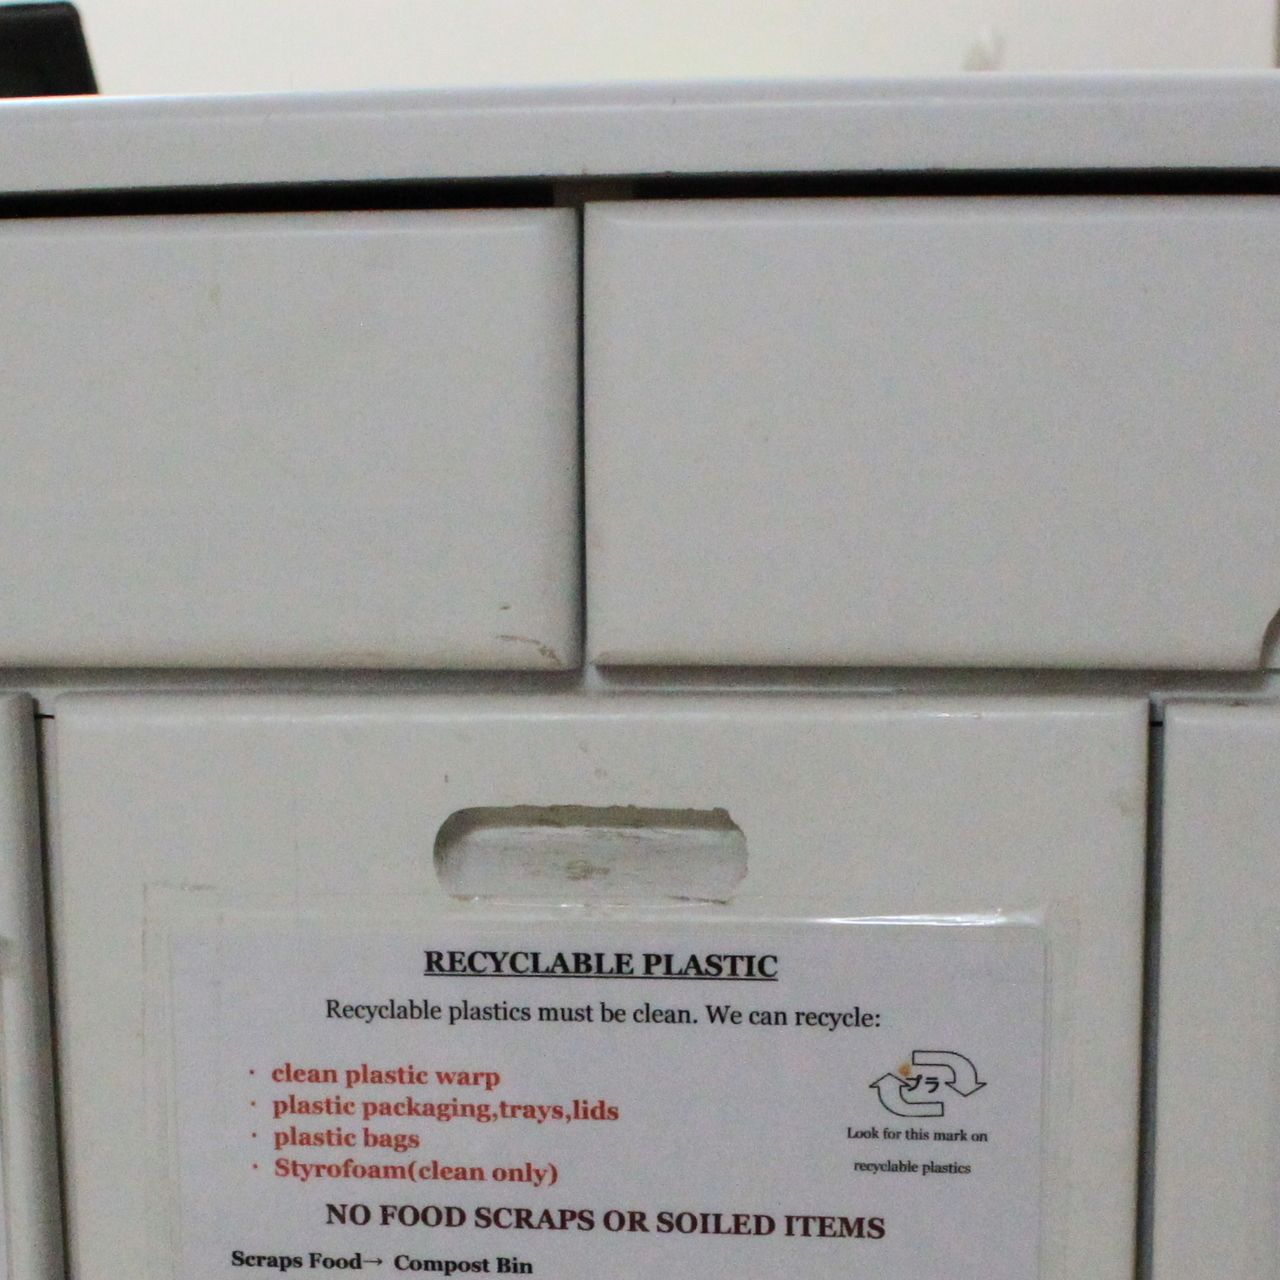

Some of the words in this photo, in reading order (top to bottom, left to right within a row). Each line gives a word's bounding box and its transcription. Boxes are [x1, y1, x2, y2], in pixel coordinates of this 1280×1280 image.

[423, 949, 635, 975] RECYCLABLE
[642, 952, 779, 978] PLASTIC
[325, 998, 443, 1025] Recyclable
[448, 998, 533, 1026] plastics
[537, 1004, 594, 1024] must
[599, 1000, 627, 1024] be
[631, 1001, 699, 1025] clean.
[704, 1003, 744, 1026] We
[747, 1009, 789, 1027] can
[794, 1005, 881, 1033] recycle:
[270, 1061, 339, 1084] clean
[344, 1062, 429, 1090] plastic
[435, 1070, 502, 1092] warp
[272, 1093, 356, 1120] plastic
[273, 1124, 357, 1152] plastic
[362, 1126, 421, 1153] bags
[846, 1125, 880, 1140] Look
[881, 1126, 903, 1141] for
[903, 1127, 931, 1142] this
[932, 1128, 969, 1143] mark
[969, 1132, 989, 1143] on
[491, 1162, 559, 1188] only)
[853, 1159, 920, 1175] recyclable
[920, 1159, 972, 1177] plastics
[325, 1203, 372, 1227] NO
[379, 1204, 468, 1228] FOOD
[474, 1206, 596, 1232] SCRAPS
[602, 1209, 650, 1233] OR
[655, 1210, 777, 1237] SOILED
[784, 1214, 886, 1240] ITEMS
[230, 1249, 304, 1273] Scraps
[308, 1251, 363, 1271] Food
[393, 1254, 491, 1277] Compost
[495, 1256, 534, 1275] Bin
